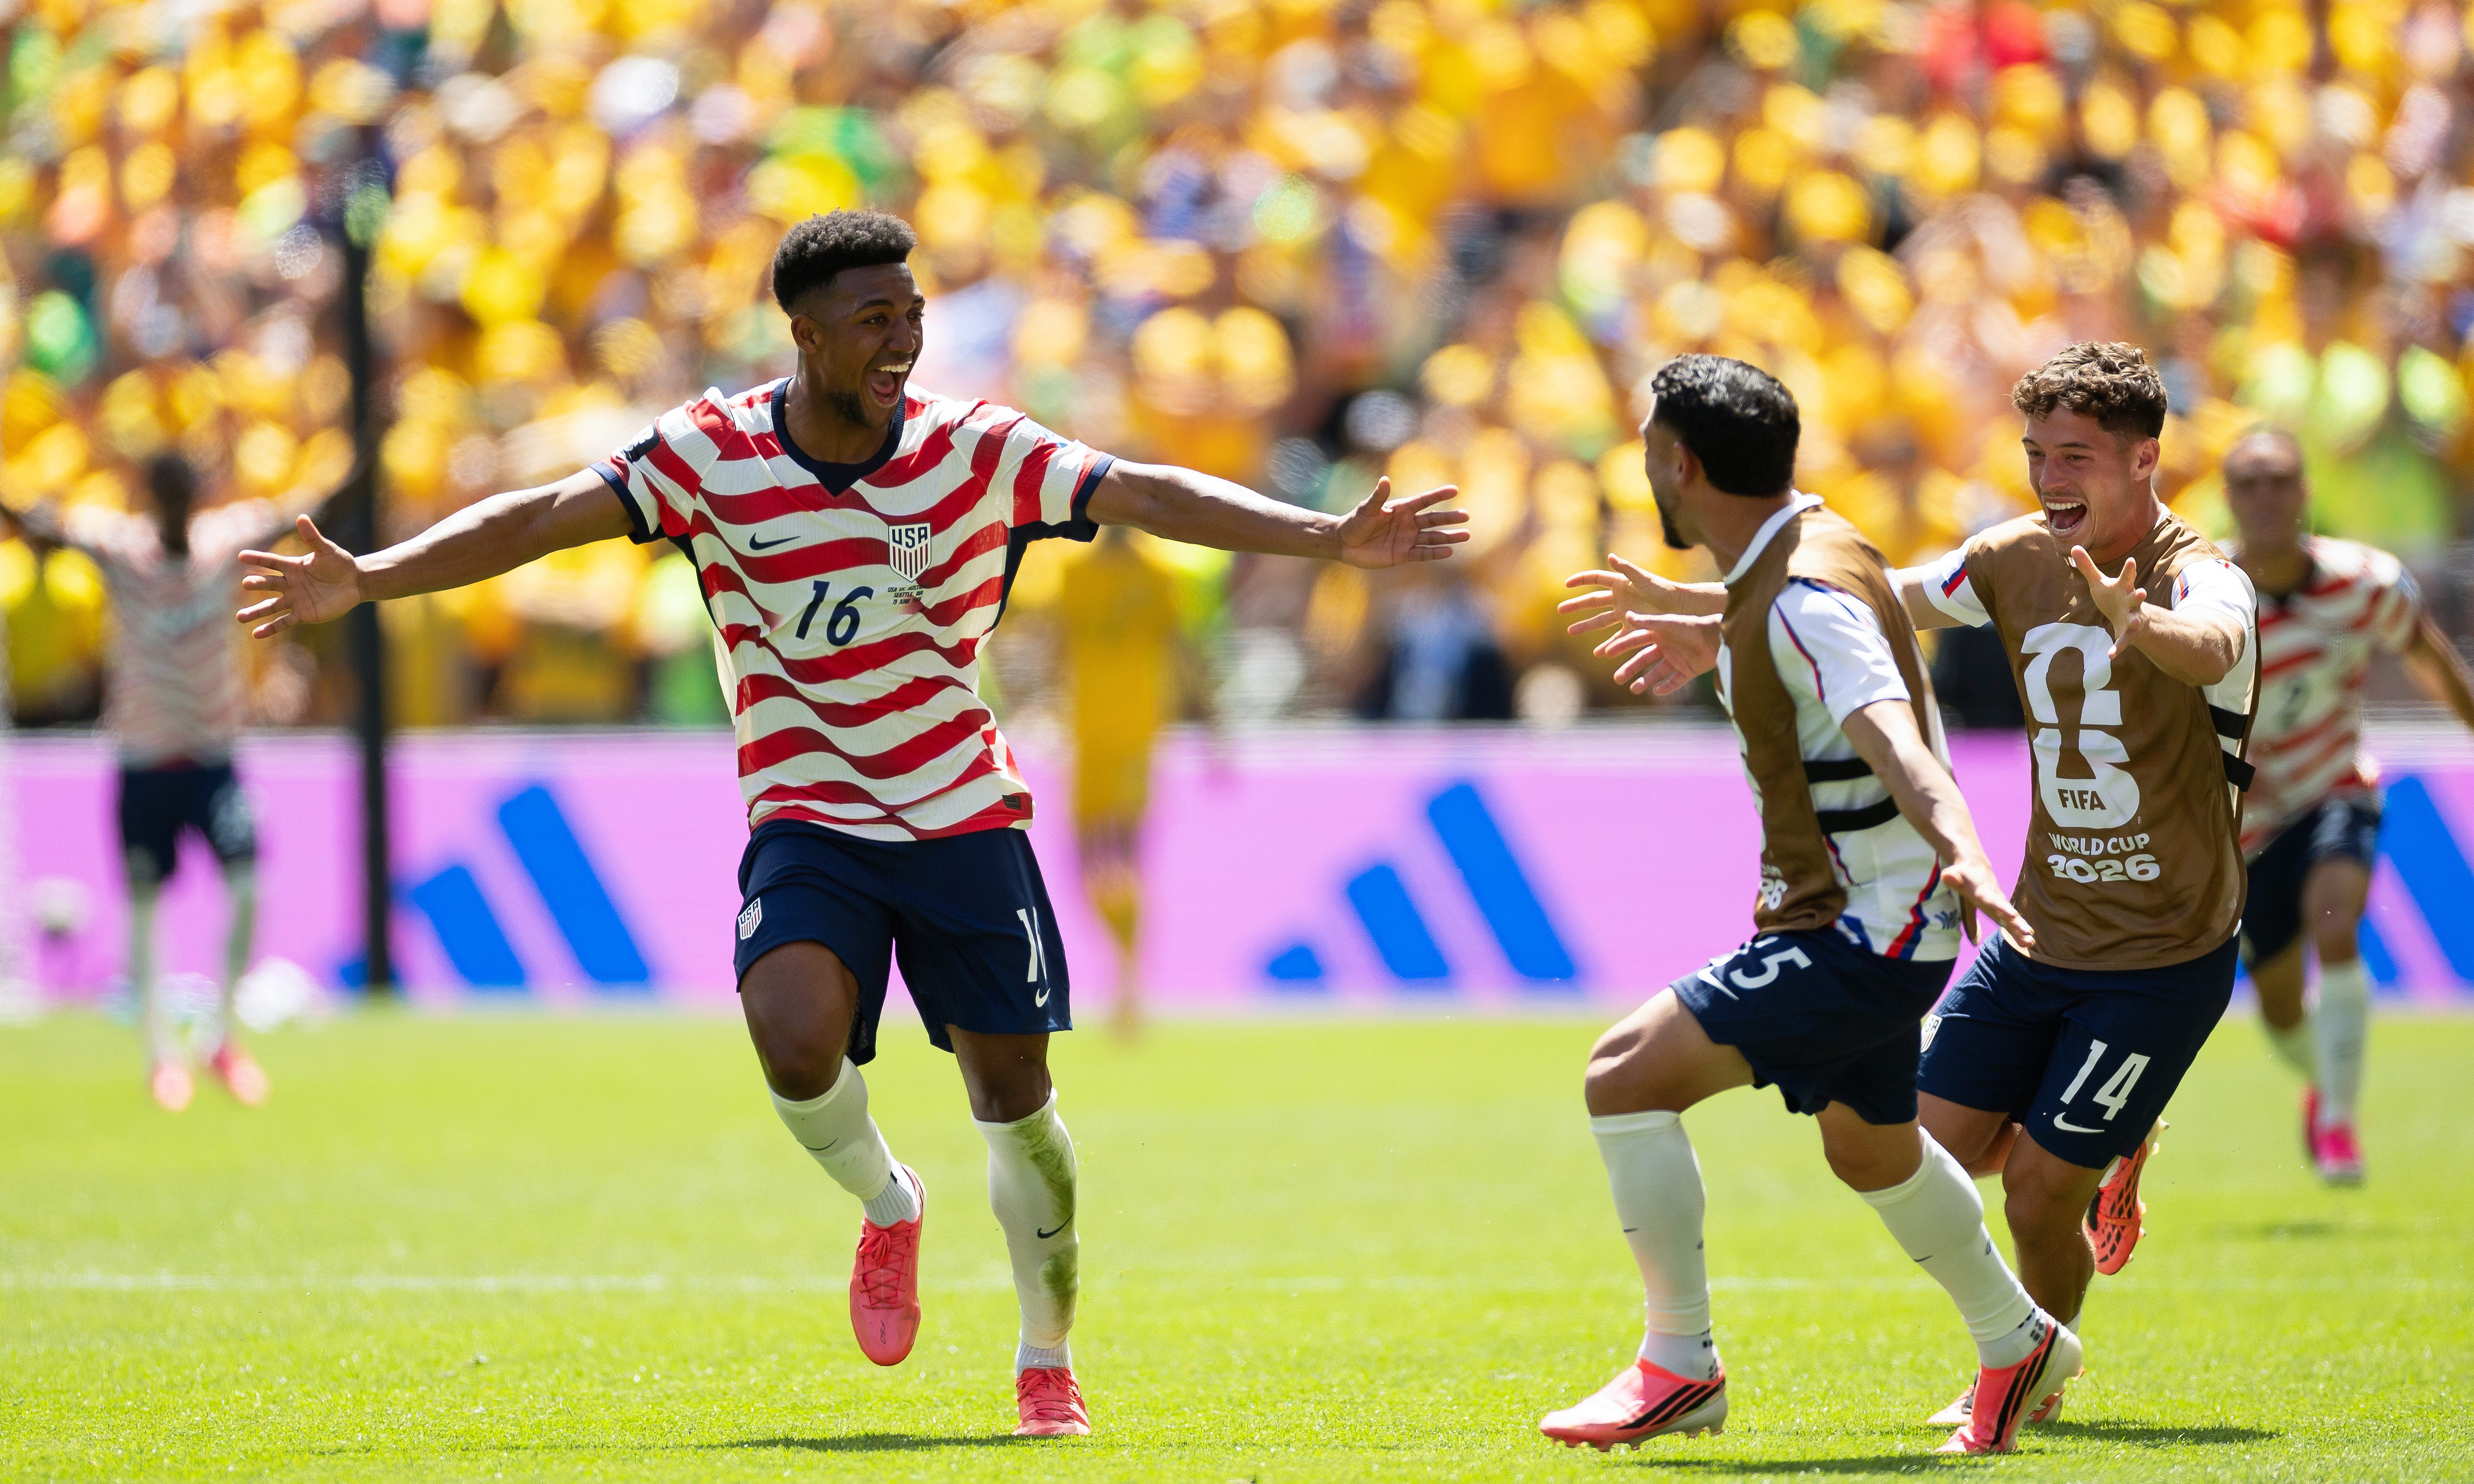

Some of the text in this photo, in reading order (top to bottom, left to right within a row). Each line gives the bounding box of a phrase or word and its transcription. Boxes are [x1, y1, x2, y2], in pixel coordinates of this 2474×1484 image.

[892, 526, 928, 549] USA
[795, 580, 874, 647] 16
[2057, 788, 2107, 810] FIFA
[2048, 832, 2150, 855] WORLD CUP
[2047, 853, 2160, 884] 2026
[740, 900, 759, 925] USA
[2060, 1039, 2151, 1121] 14
